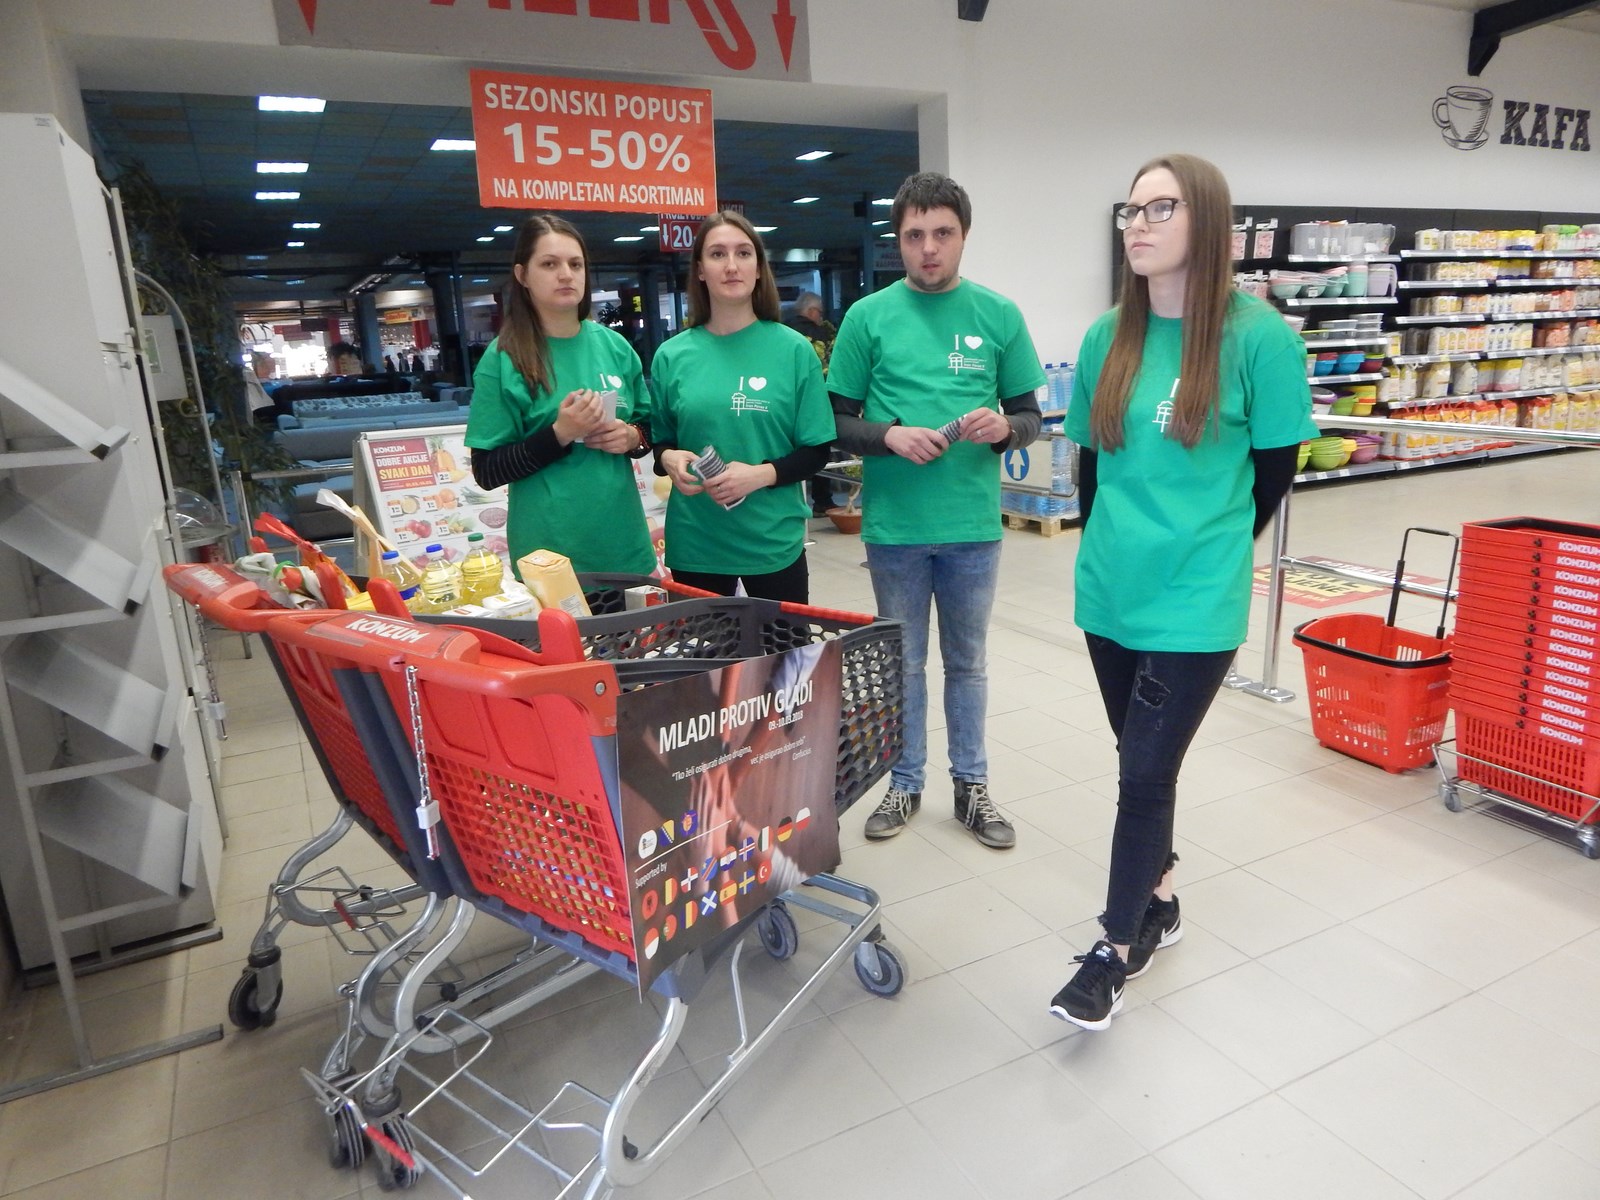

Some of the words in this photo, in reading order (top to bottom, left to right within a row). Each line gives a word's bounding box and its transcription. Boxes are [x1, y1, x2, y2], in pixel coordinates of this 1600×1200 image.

[484, 82, 607, 117] SEZONSKI
[615, 94, 704, 124] POPUST
[1500, 100, 1591, 151] KAFA
[503, 122, 691, 173] 15-50%
[493, 178, 519, 199] NA
[522, 179, 615, 203] KOMPLETAN
[619, 184, 705, 207] ASORTIMAN
[373, 445, 406, 454] KONZUM
[375, 456, 402, 467] DOBRE
[402, 454, 429, 465] AKCIJE
[378, 467, 409, 480] SVAKI
[412, 465, 432, 476] DAN
[1555, 570, 1600, 586] KONZUM
[1553, 585, 1599, 601] KONZUM
[1552, 599, 1598, 616] KONZUM
[345, 618, 430, 643] KONZUM
[1551, 614, 1596, 631] KONZUM
[1550, 628, 1595, 646] KONZUM
[1549, 642, 1593, 660] KONZUM
[1546, 656, 1591, 675] KONZUM
[1545, 670, 1590, 689] KONZUM
[1543, 684, 1588, 703] KONZUM
[659, 711, 716, 754] MLADI
[719, 692, 772, 734] PROTIV
[774, 679, 813, 714] GLADI
[1542, 698, 1586, 718] KONZUM
[1541, 712, 1585, 732] KONZUM
[1539, 726, 1583, 746] KONZUM
[634, 864, 661, 889] Supported
[660, 861, 668, 873] by
